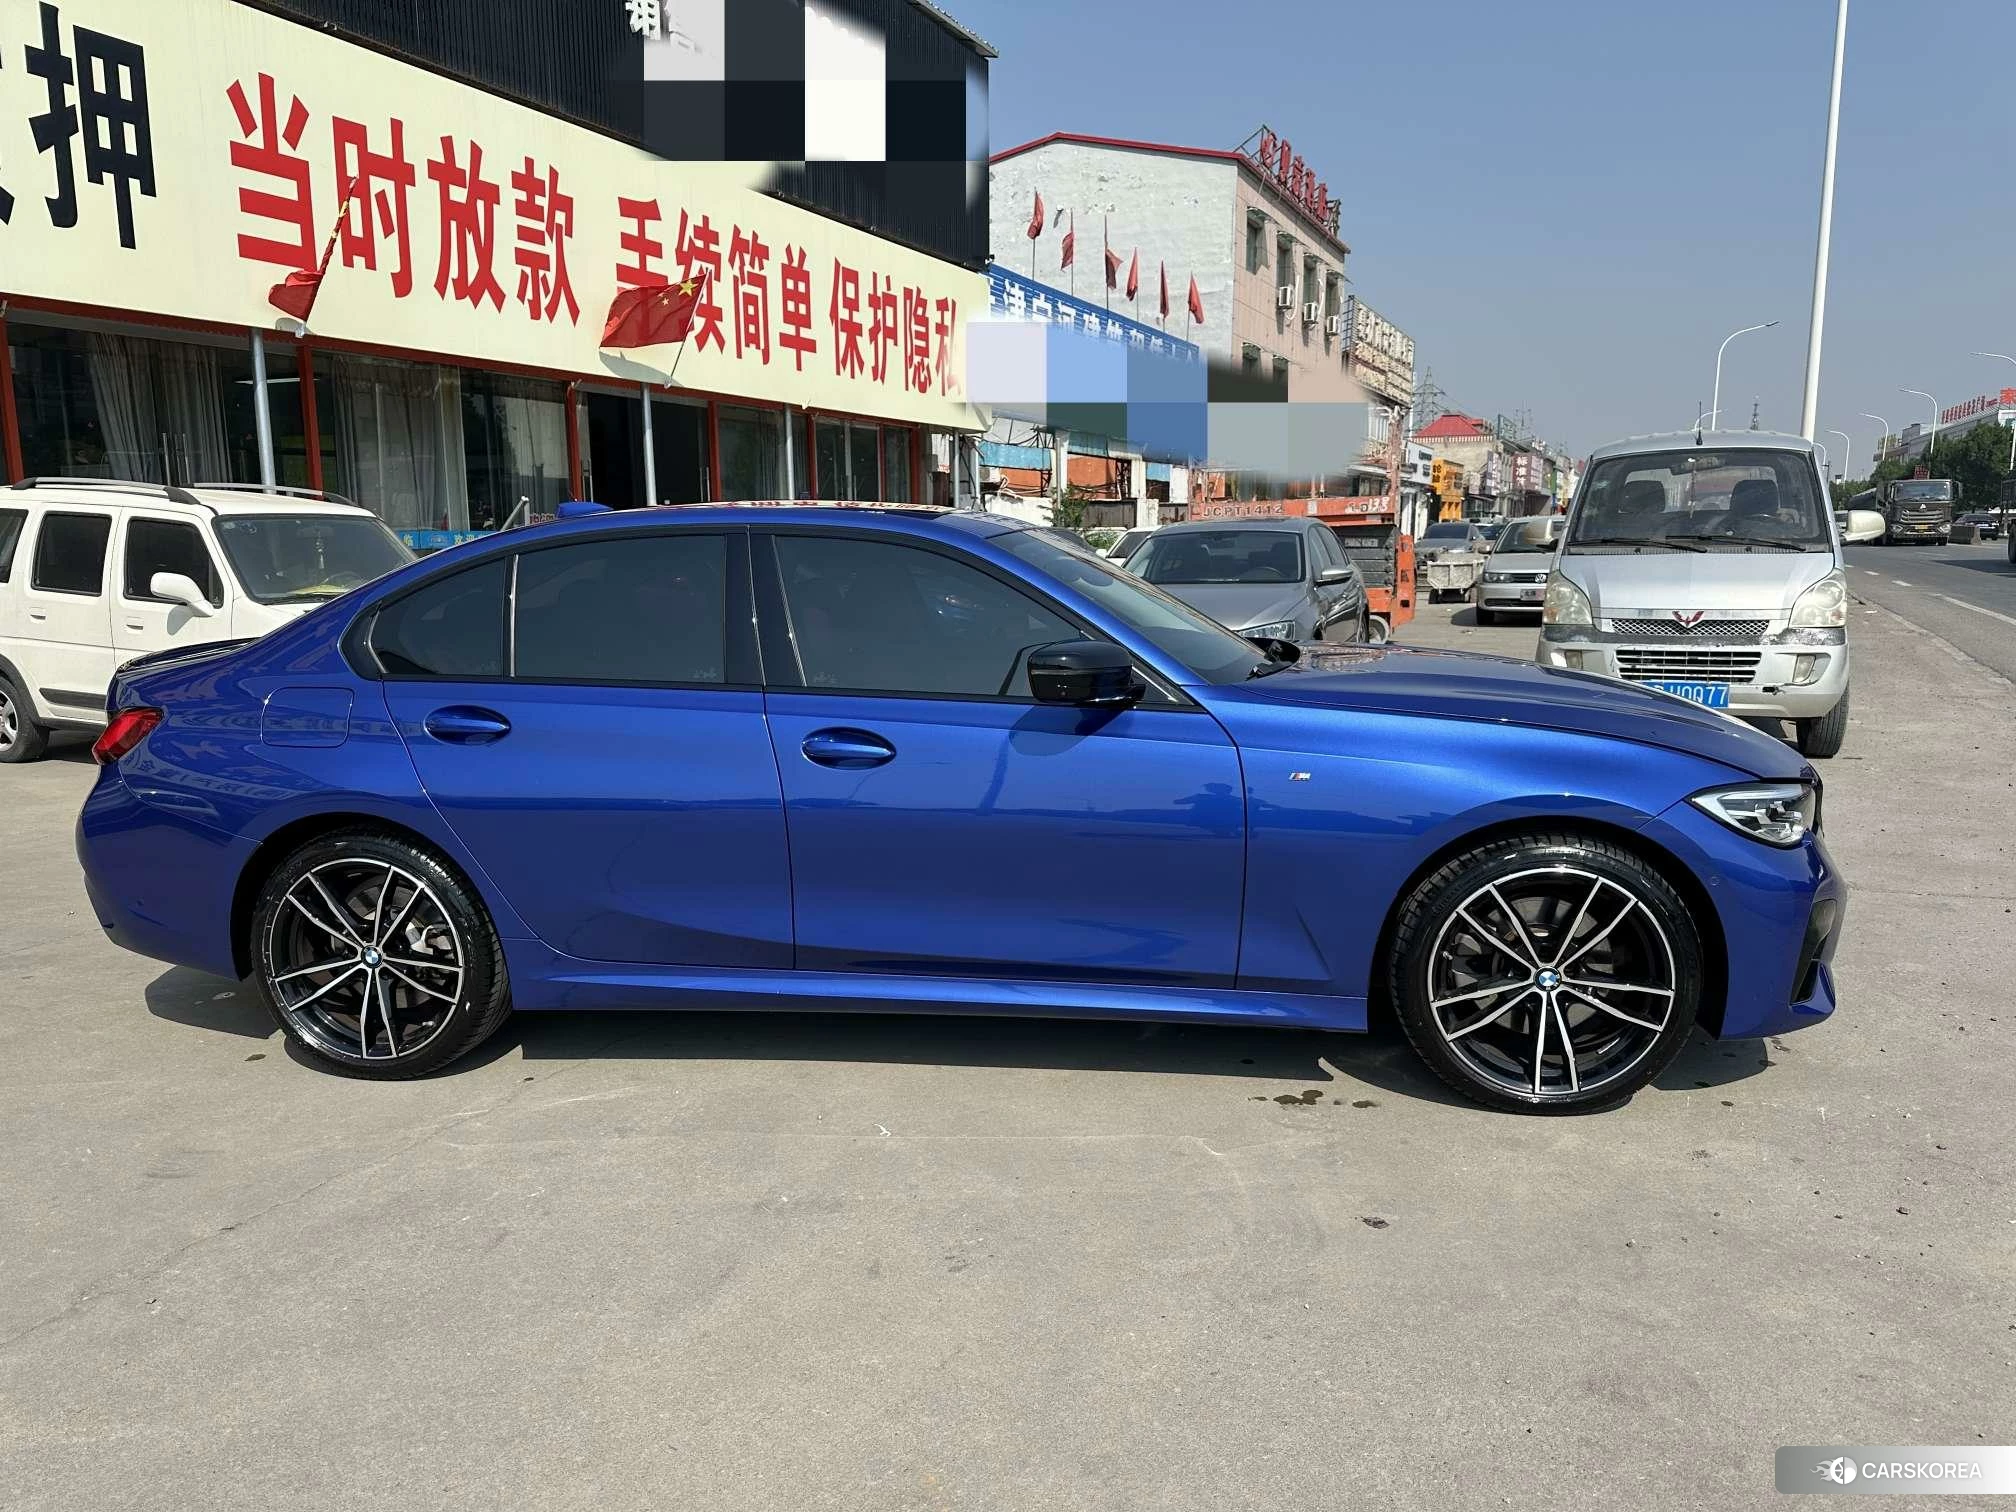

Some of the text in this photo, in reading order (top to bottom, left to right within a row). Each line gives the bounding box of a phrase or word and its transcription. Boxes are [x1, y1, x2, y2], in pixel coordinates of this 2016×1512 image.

[0, 0, 157, 250] 押
[226, 72, 580, 327] 当时放款
[615, 195, 817, 372] 手续简单
[1203, 503, 1283, 517] JCPT1412
